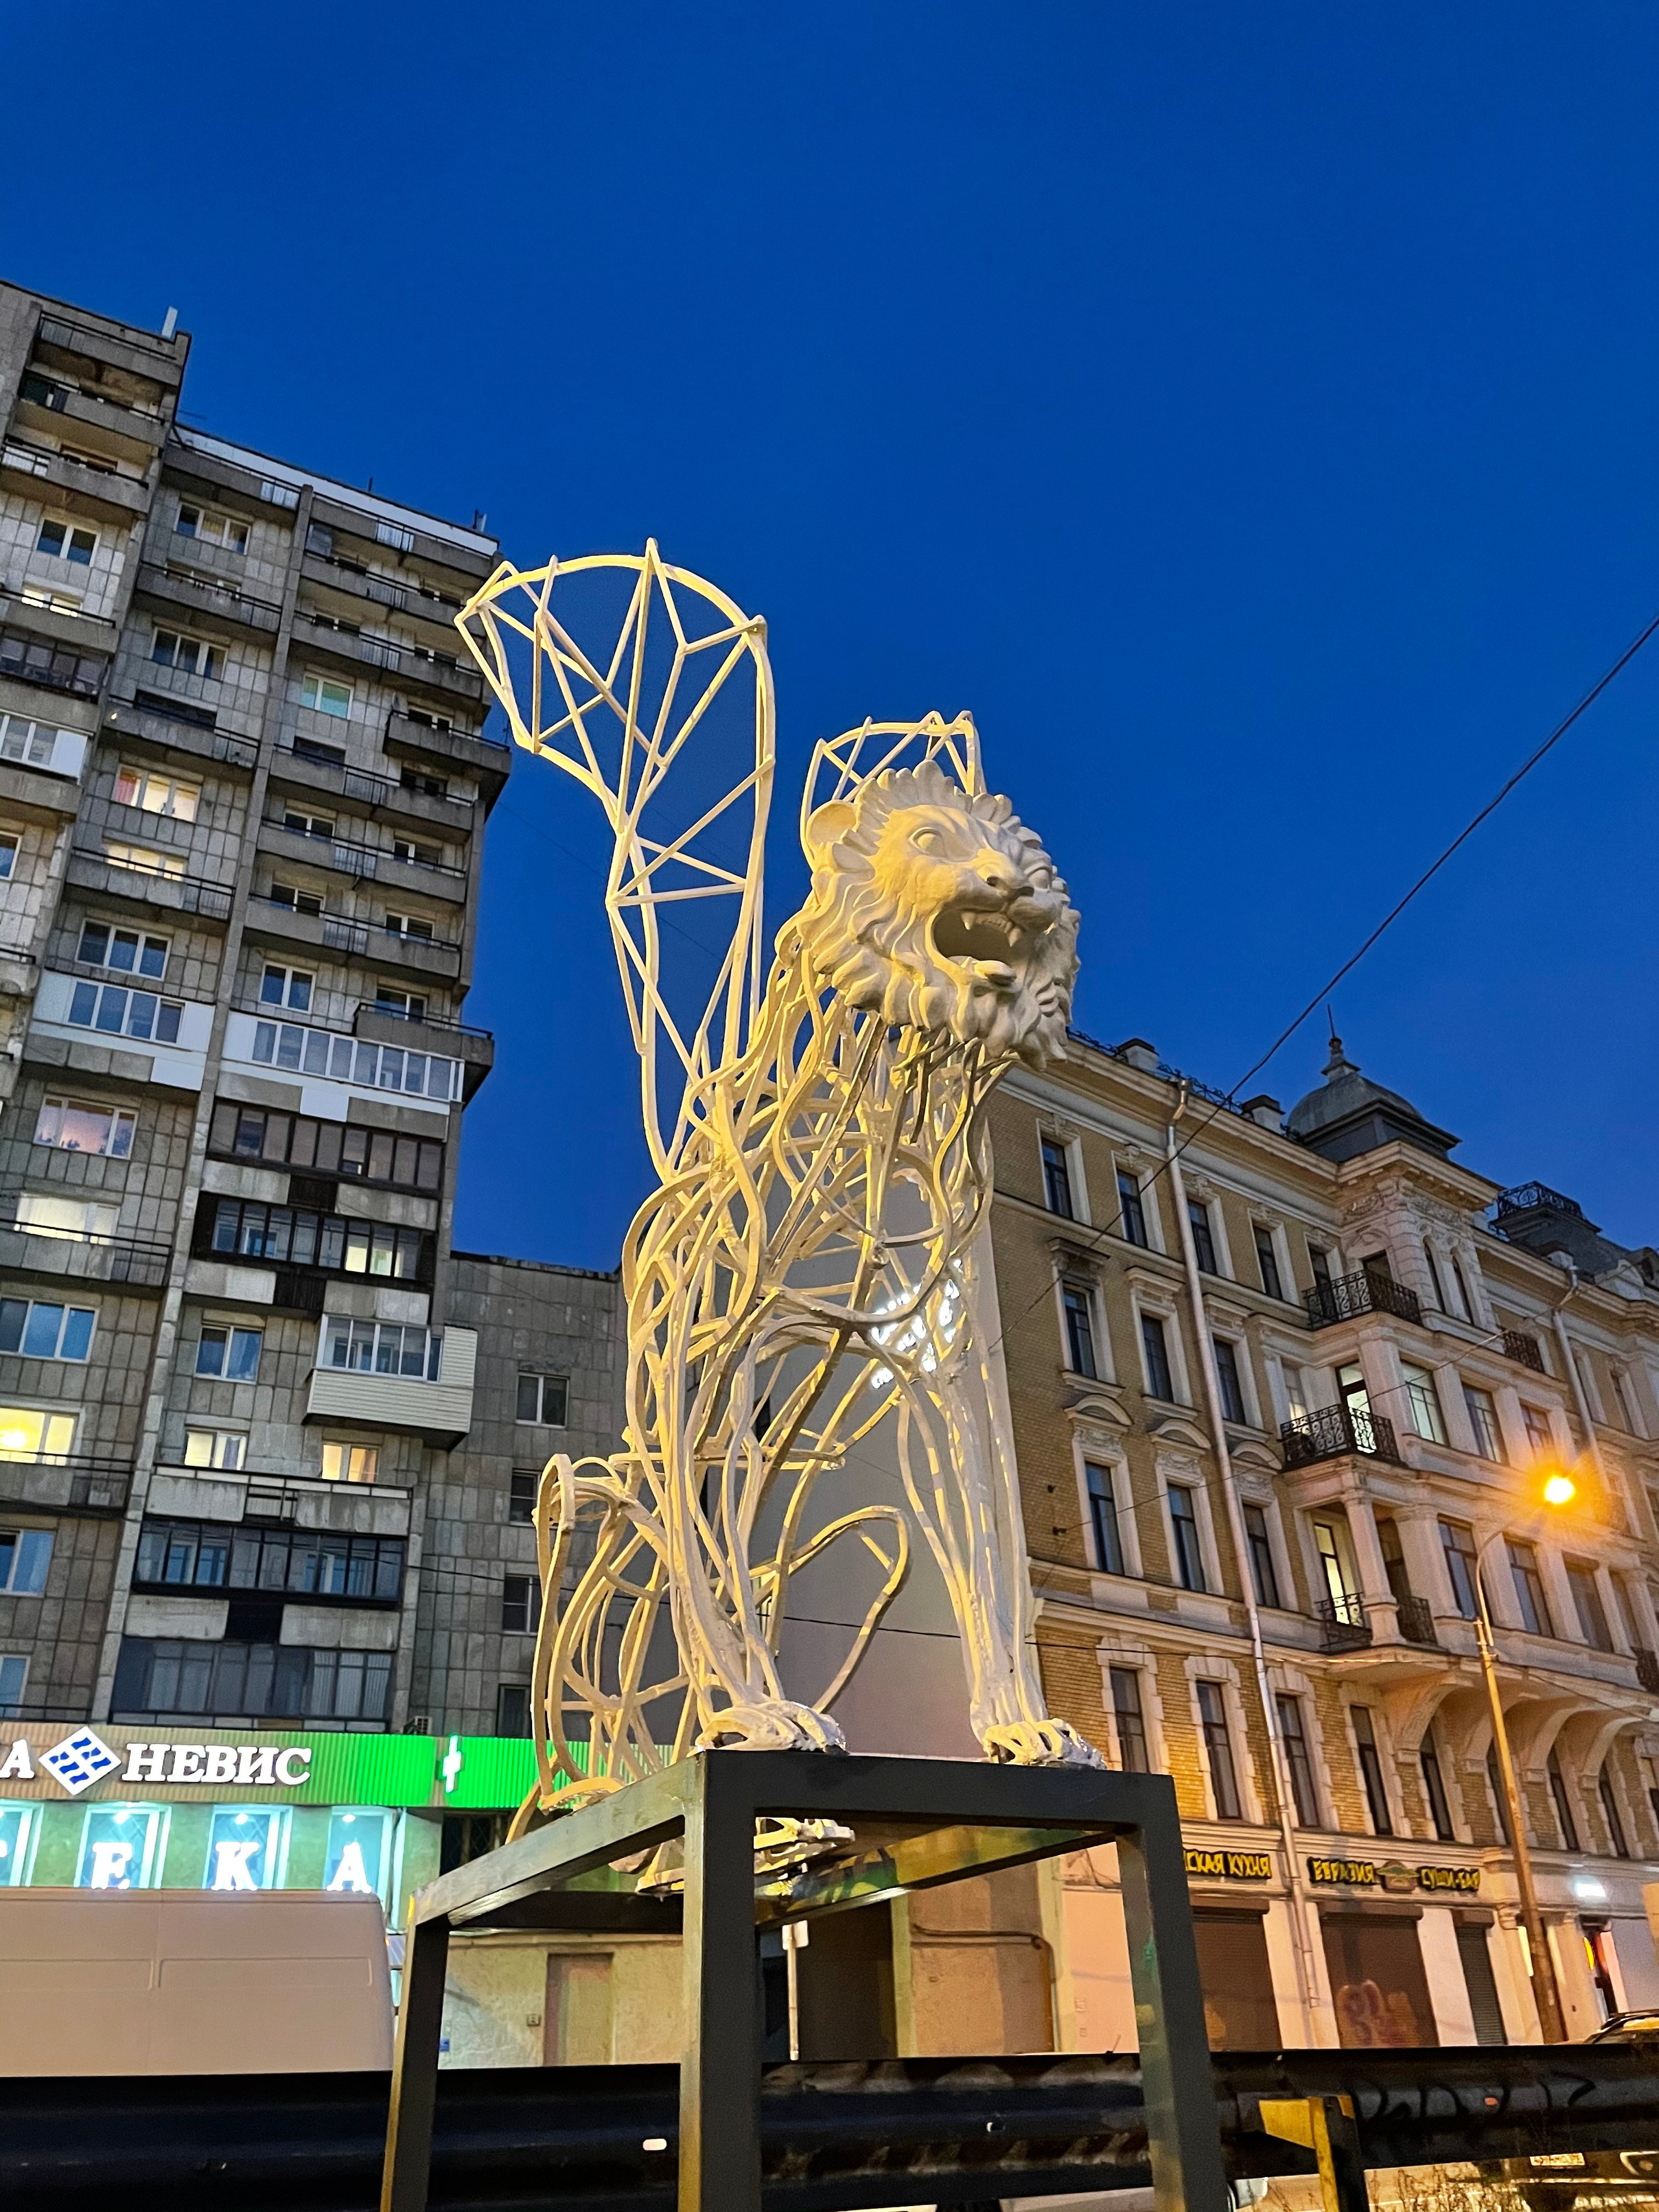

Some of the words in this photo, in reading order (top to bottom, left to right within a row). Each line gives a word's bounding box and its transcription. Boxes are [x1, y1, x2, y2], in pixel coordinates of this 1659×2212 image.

[121, 1743, 312, 1786] НЕВИС
[0, 1840, 372, 1894] ЕКА
[1185, 1850, 1226, 1874] СКАЯ
[1228, 1852, 1272, 1877] КУХНЯ
[1312, 1860, 1376, 1883] ЕВРАЗИЯ
